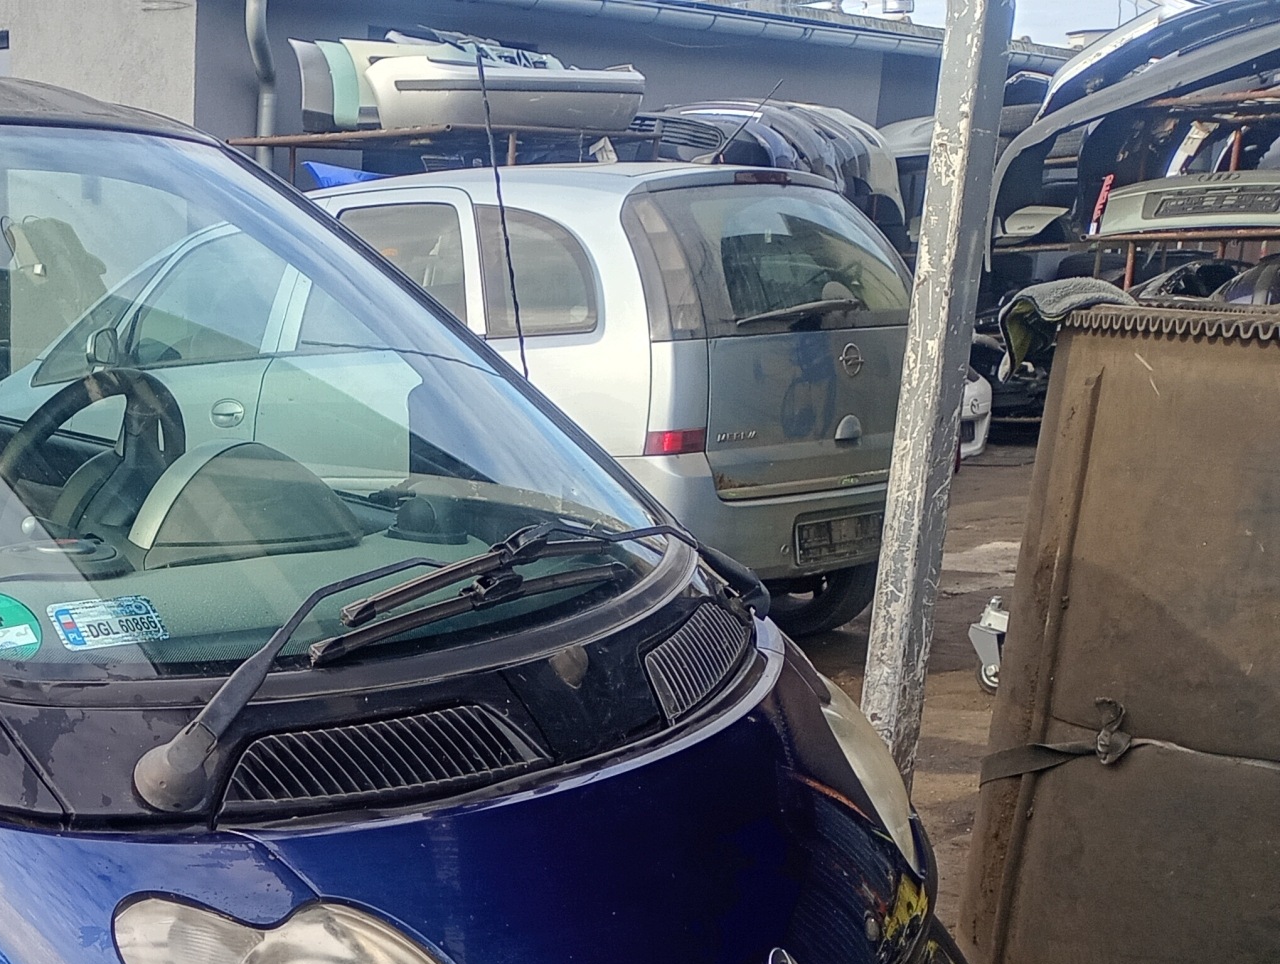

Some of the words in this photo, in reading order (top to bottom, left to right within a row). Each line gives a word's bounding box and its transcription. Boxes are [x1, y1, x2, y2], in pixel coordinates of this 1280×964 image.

[86, 620, 120, 639] DGL
[118, 615, 158, 634] 60866
[68, 632, 83, 642] PL
